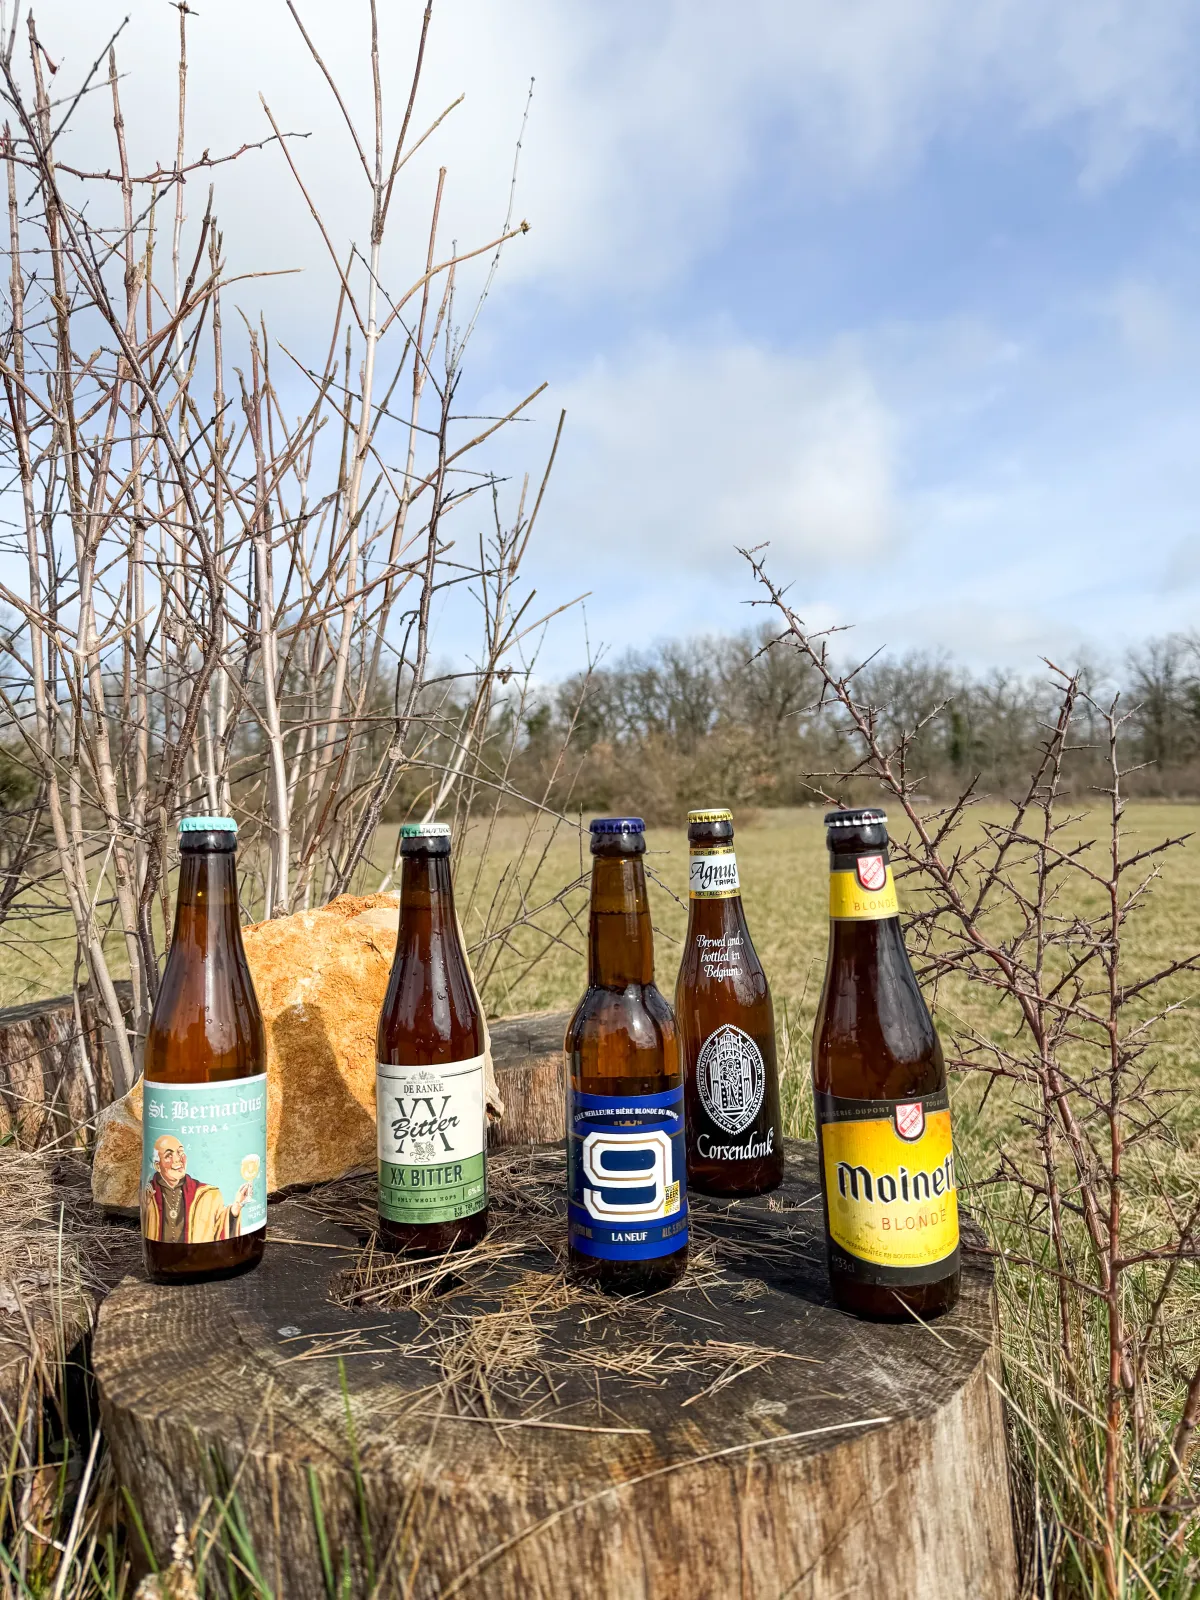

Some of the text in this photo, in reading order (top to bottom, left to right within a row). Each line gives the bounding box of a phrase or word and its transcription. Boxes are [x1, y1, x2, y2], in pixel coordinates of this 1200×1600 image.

[690, 861, 736, 889] Agnus
[714, 878, 737, 886] TRIPEL
[854, 898, 896, 911] BLONDE
[696, 930, 744, 947] Brewed and
[700, 947, 741, 962] bottled in
[704, 963, 743, 983] Belgium
[404, 1083, 444, 1094] DE RANKE
[148, 1094, 262, 1121] St. Bernardus
[615, 1107, 634, 1115] BIÈRE
[855, 1106, 890, 1115] DUPONT
[181, 1124, 218, 1135] EXTRA
[391, 1116, 460, 1140] Bitter
[697, 1127, 774, 1160] Corsendonk
[390, 1165, 463, 1187] XX BITTER
[583, 1129, 673, 1222] 9
[881, 1208, 947, 1230] BLONDE
[611, 1232, 648, 1242] LA NEUF
